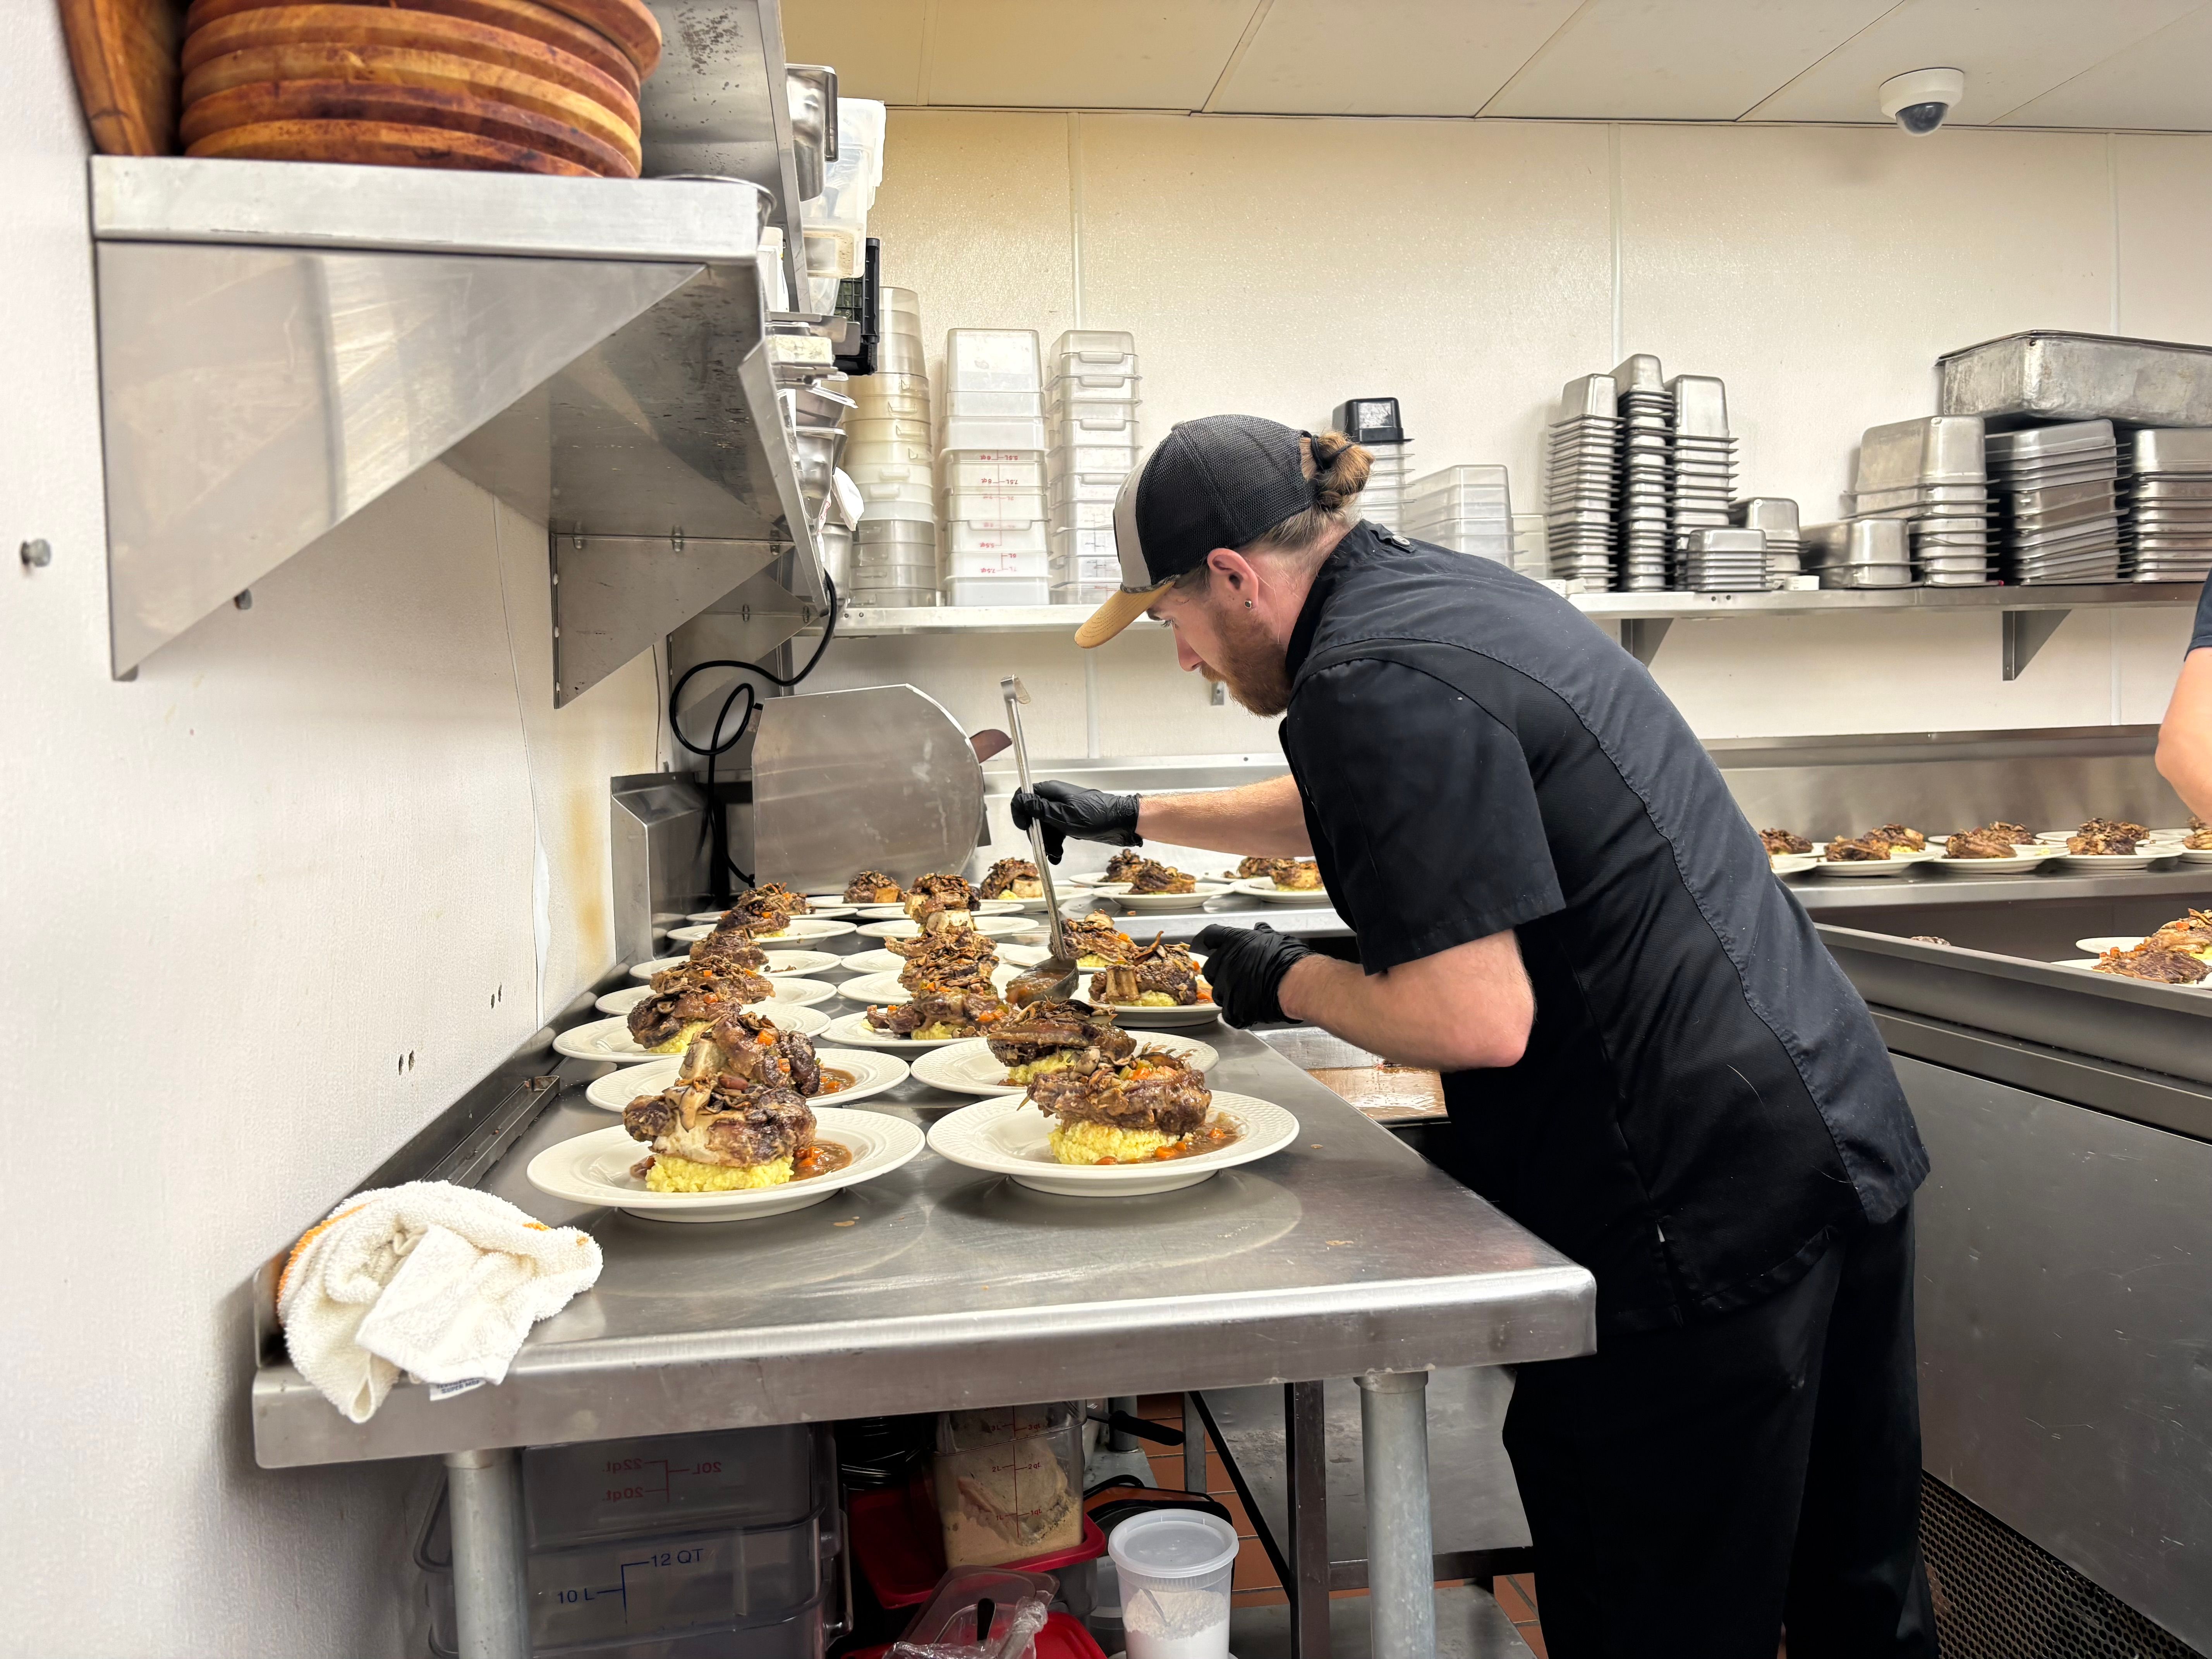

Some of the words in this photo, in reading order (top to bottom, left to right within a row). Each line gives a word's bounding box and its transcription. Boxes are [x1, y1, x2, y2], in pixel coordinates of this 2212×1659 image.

[651, 1553, 671, 1567] 12
[677, 1549, 704, 1564] QT
[558, 1590, 577, 1604] 10
[584, 1588, 595, 1601] L
